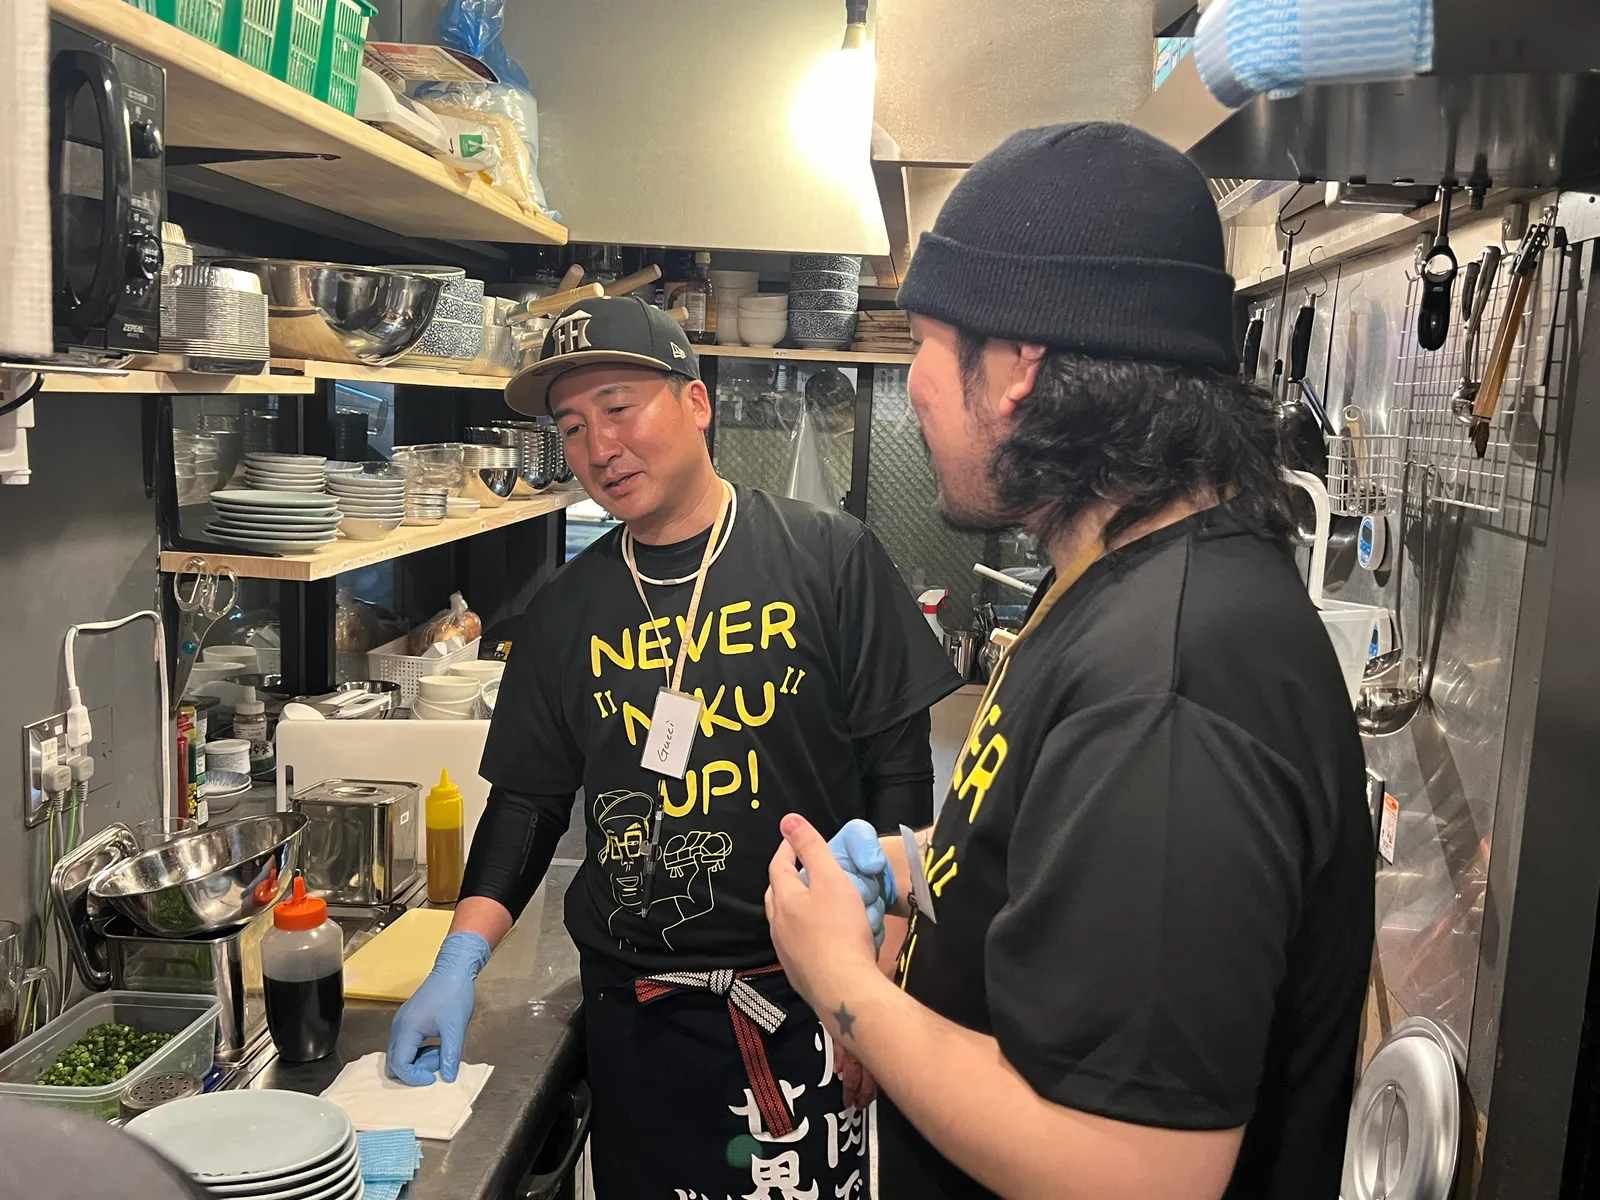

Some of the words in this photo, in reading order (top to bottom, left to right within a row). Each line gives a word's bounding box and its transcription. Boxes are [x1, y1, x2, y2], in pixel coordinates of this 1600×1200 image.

[590, 600, 797, 678] NEVER
[657, 719, 675, 763] Gucci
[661, 749, 760, 818] UP!
